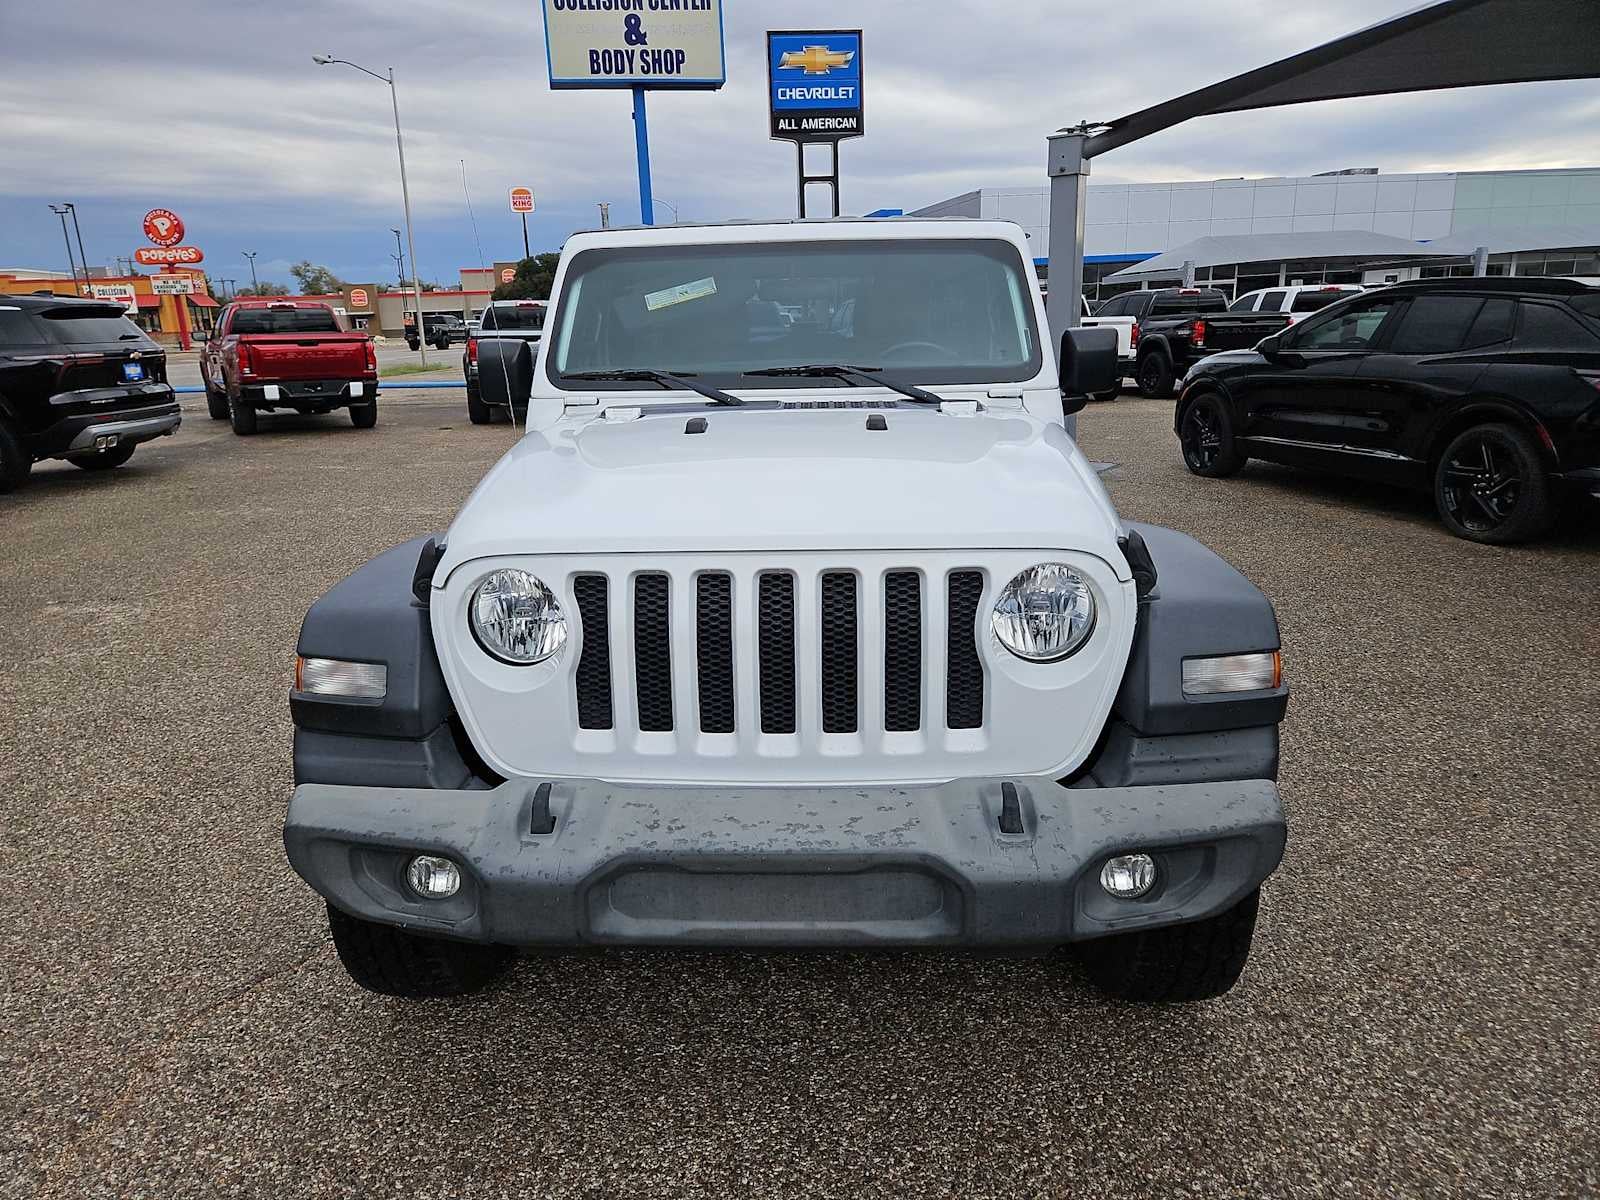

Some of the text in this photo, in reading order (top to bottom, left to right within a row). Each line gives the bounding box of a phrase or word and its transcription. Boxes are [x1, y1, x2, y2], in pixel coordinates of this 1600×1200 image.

[624, 13, 648, 46] &
[588, 49, 685, 75] BODY SHOP
[777, 87, 855, 100] CHEVROLET
[778, 117, 857, 130] ALL AMERICAN
